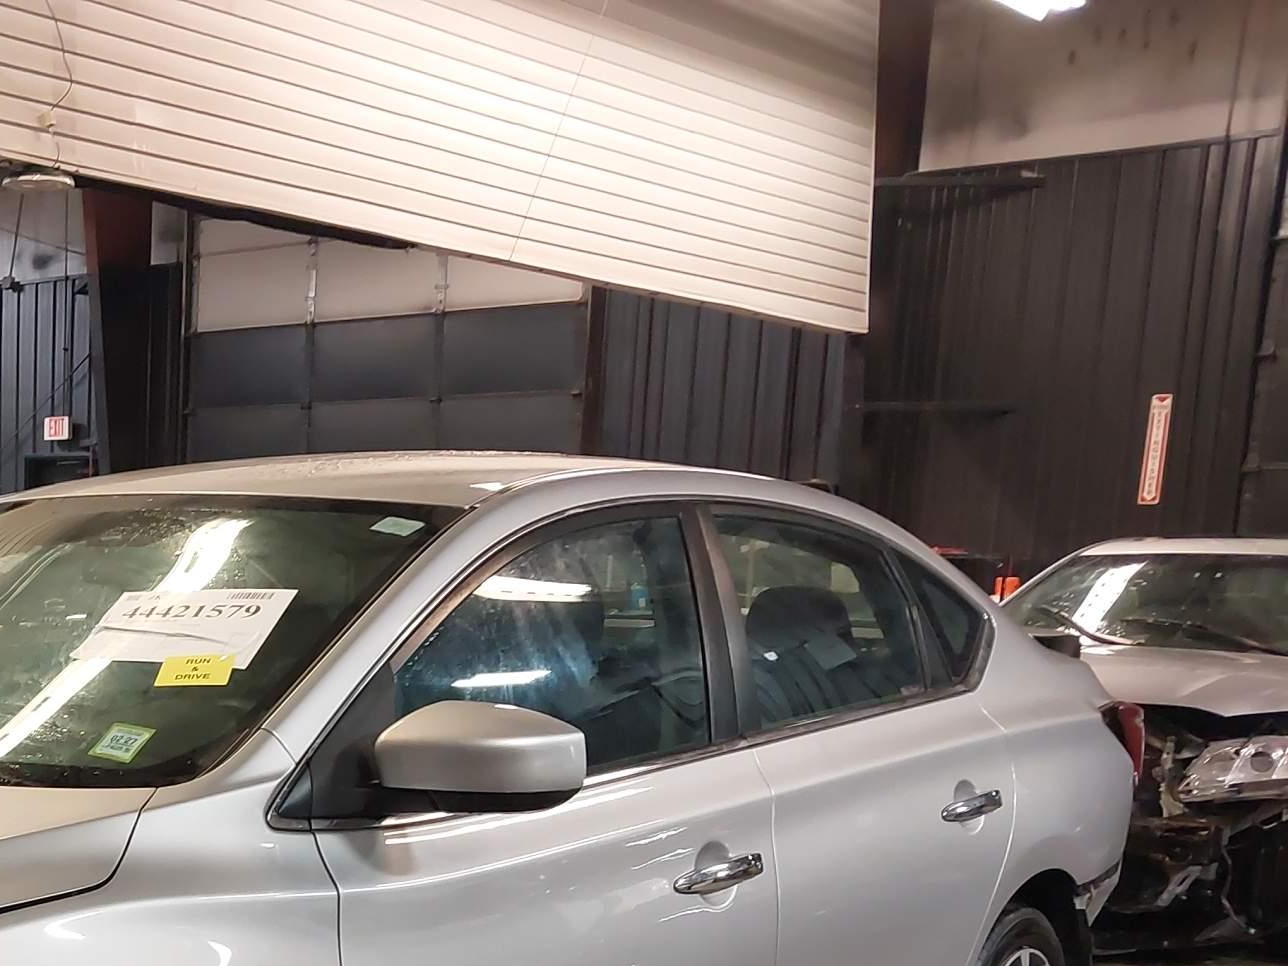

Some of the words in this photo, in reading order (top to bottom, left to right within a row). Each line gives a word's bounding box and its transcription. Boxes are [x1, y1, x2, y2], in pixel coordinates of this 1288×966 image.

[49, 418, 64, 437] EXIT
[122, 604, 262, 619] 44421579
[174, 673, 212, 681] DRIVE
